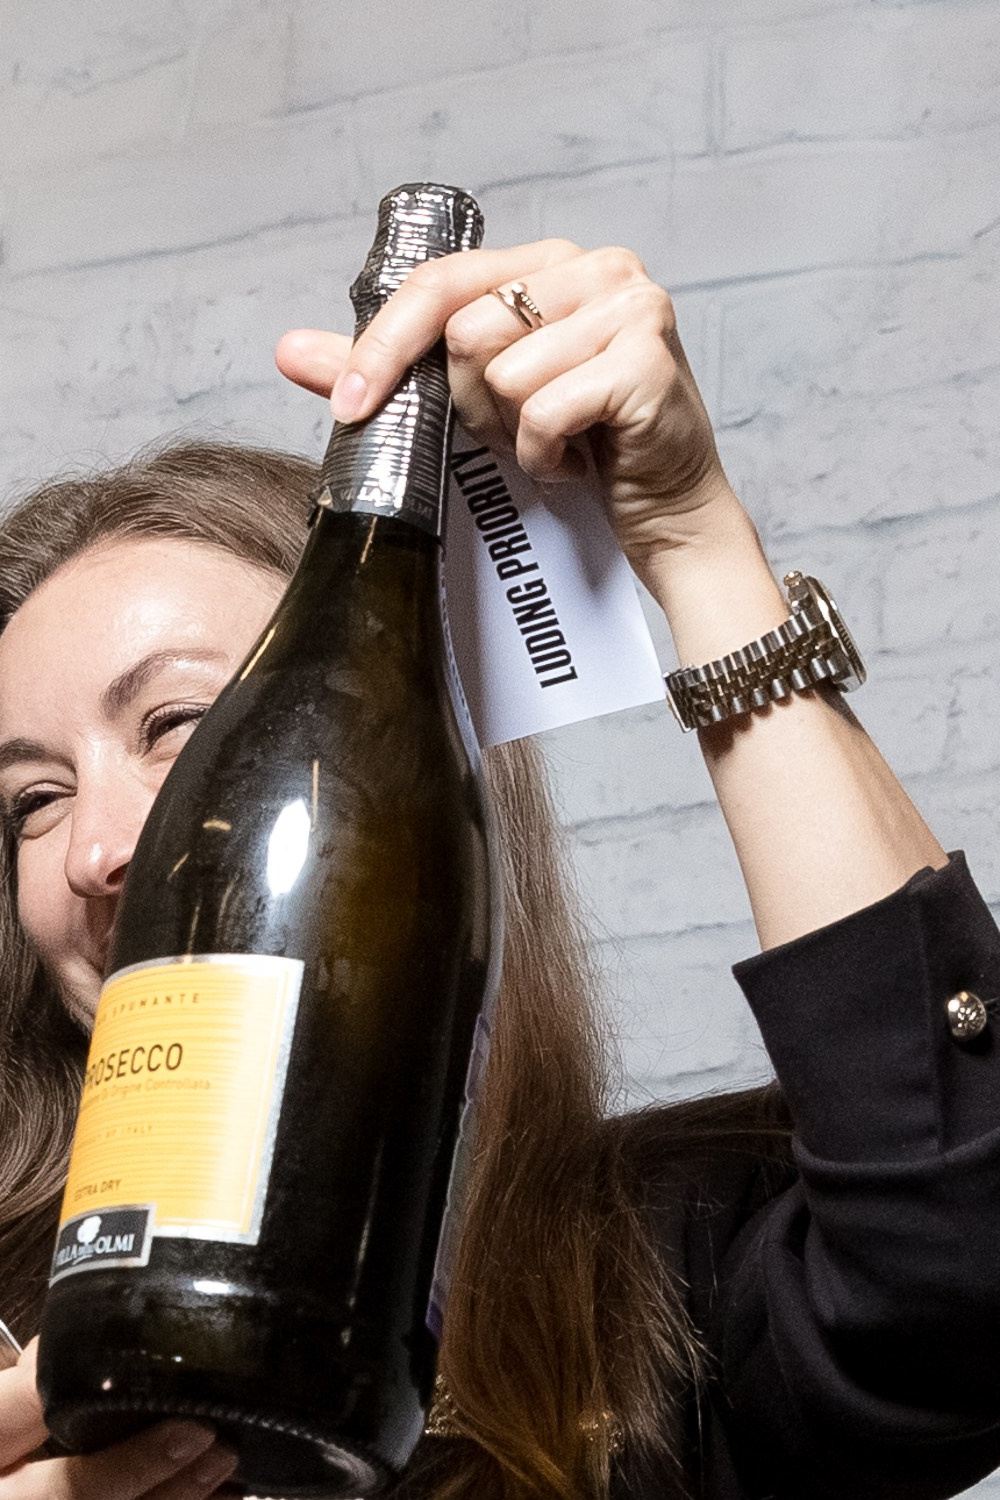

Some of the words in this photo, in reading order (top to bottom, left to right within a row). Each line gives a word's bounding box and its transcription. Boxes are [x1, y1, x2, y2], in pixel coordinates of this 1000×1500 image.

[450, 446, 540, 581] PRIORITY
[506, 577, 579, 689] LUDING
[95, 1232, 136, 1255] OLMI
